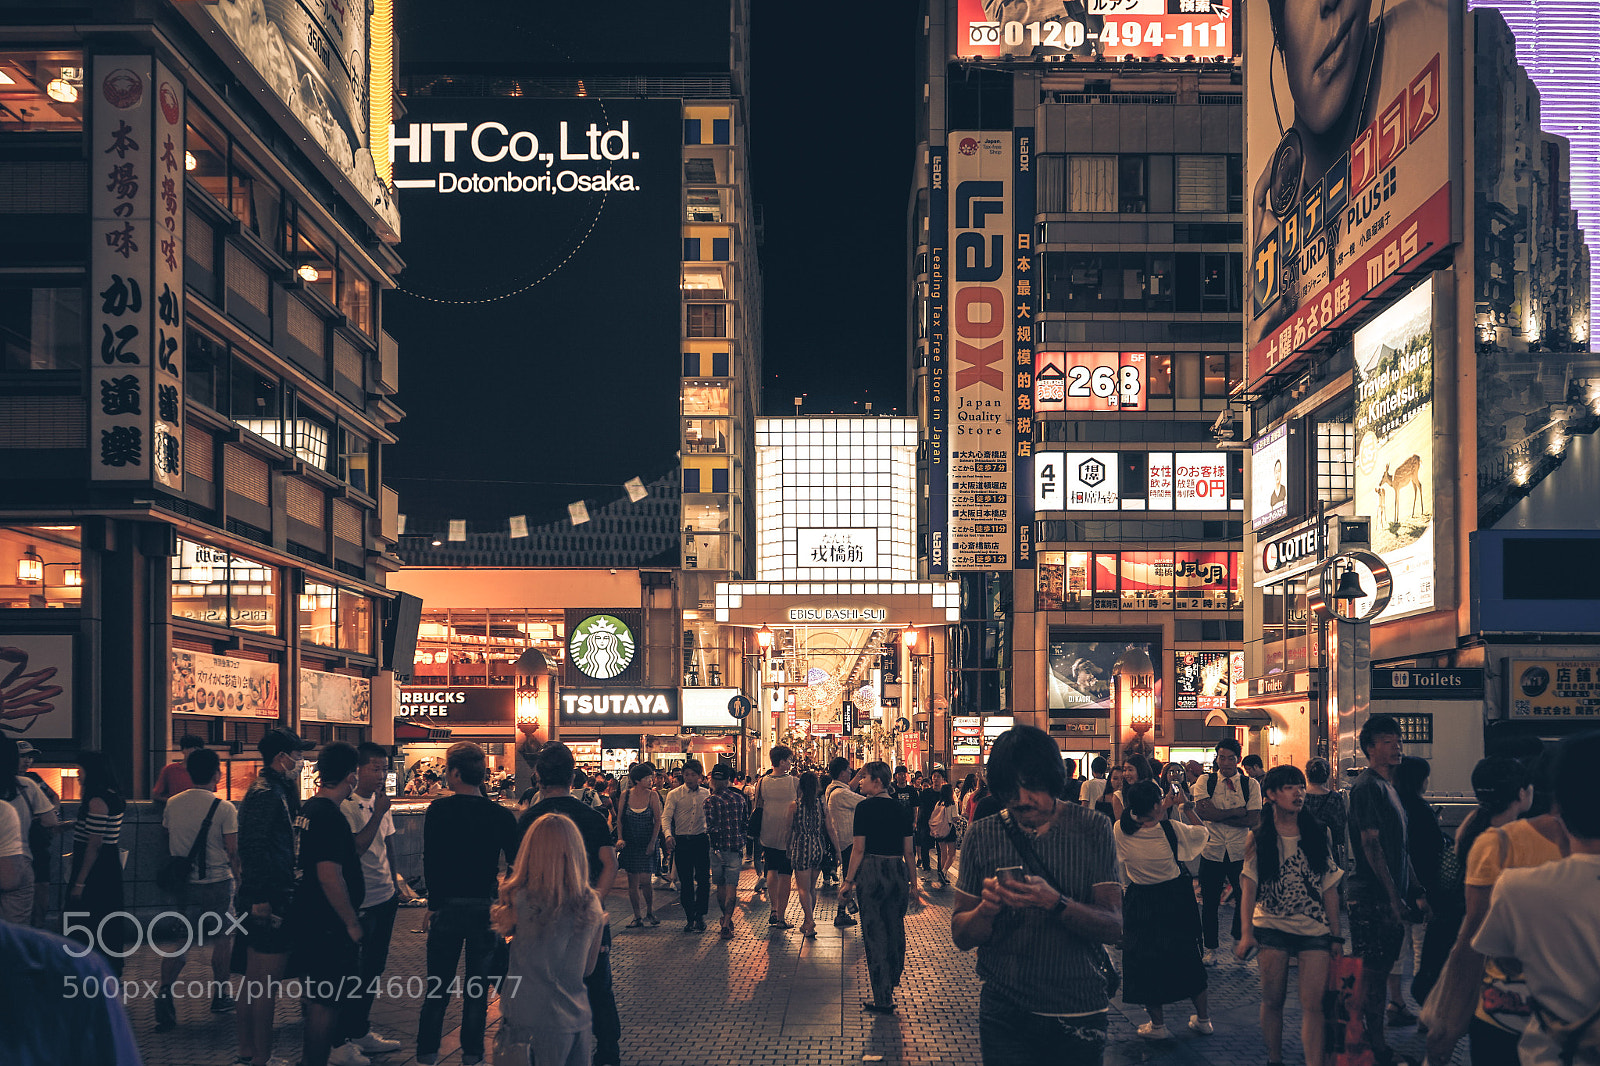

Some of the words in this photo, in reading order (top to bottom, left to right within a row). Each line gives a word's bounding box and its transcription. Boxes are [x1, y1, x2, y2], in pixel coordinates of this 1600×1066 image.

[308, 24, 330, 71] 350ml
[1004, 21, 1226, 48] 0120-494-111
[105, 120, 139, 259] 本場の味
[160, 133, 178, 272] 本場の味
[1281, 218, 1343, 296] SATURDAY
[1347, 183, 1382, 235] PLUS
[931, 247, 943, 299] Leading
[932, 304, 943, 327] Tax
[1265, 277, 1351, 373] 土曜あさ8時
[932, 333, 943, 363] Free
[1017, 233, 1032, 457] 日本最大规模的免税店
[1130, 353, 1145, 362] 5F
[932, 367, 943, 402] Store
[1358, 365, 1390, 402] Travel
[1391, 368, 1400, 383] to
[1400, 345, 1429, 377] Nara
[933, 408, 943, 420] in
[957, 396, 1002, 410] Japan
[1358, 415, 1368, 429] on
[1368, 383, 1419, 424] Kintetsu.
[957, 410, 1002, 424] Quality
[957, 425, 1002, 435] Store
[931, 426, 943, 465] Japan
[1196, 479, 1226, 498] 0円
[811, 545, 863, 562] 戎橋筋
[790, 609, 823, 620] EBISU
[1264, 679, 1283, 692] Toilets
[1412, 672, 1462, 686] Toilets
[562, 694, 670, 714] TSUTAYA
